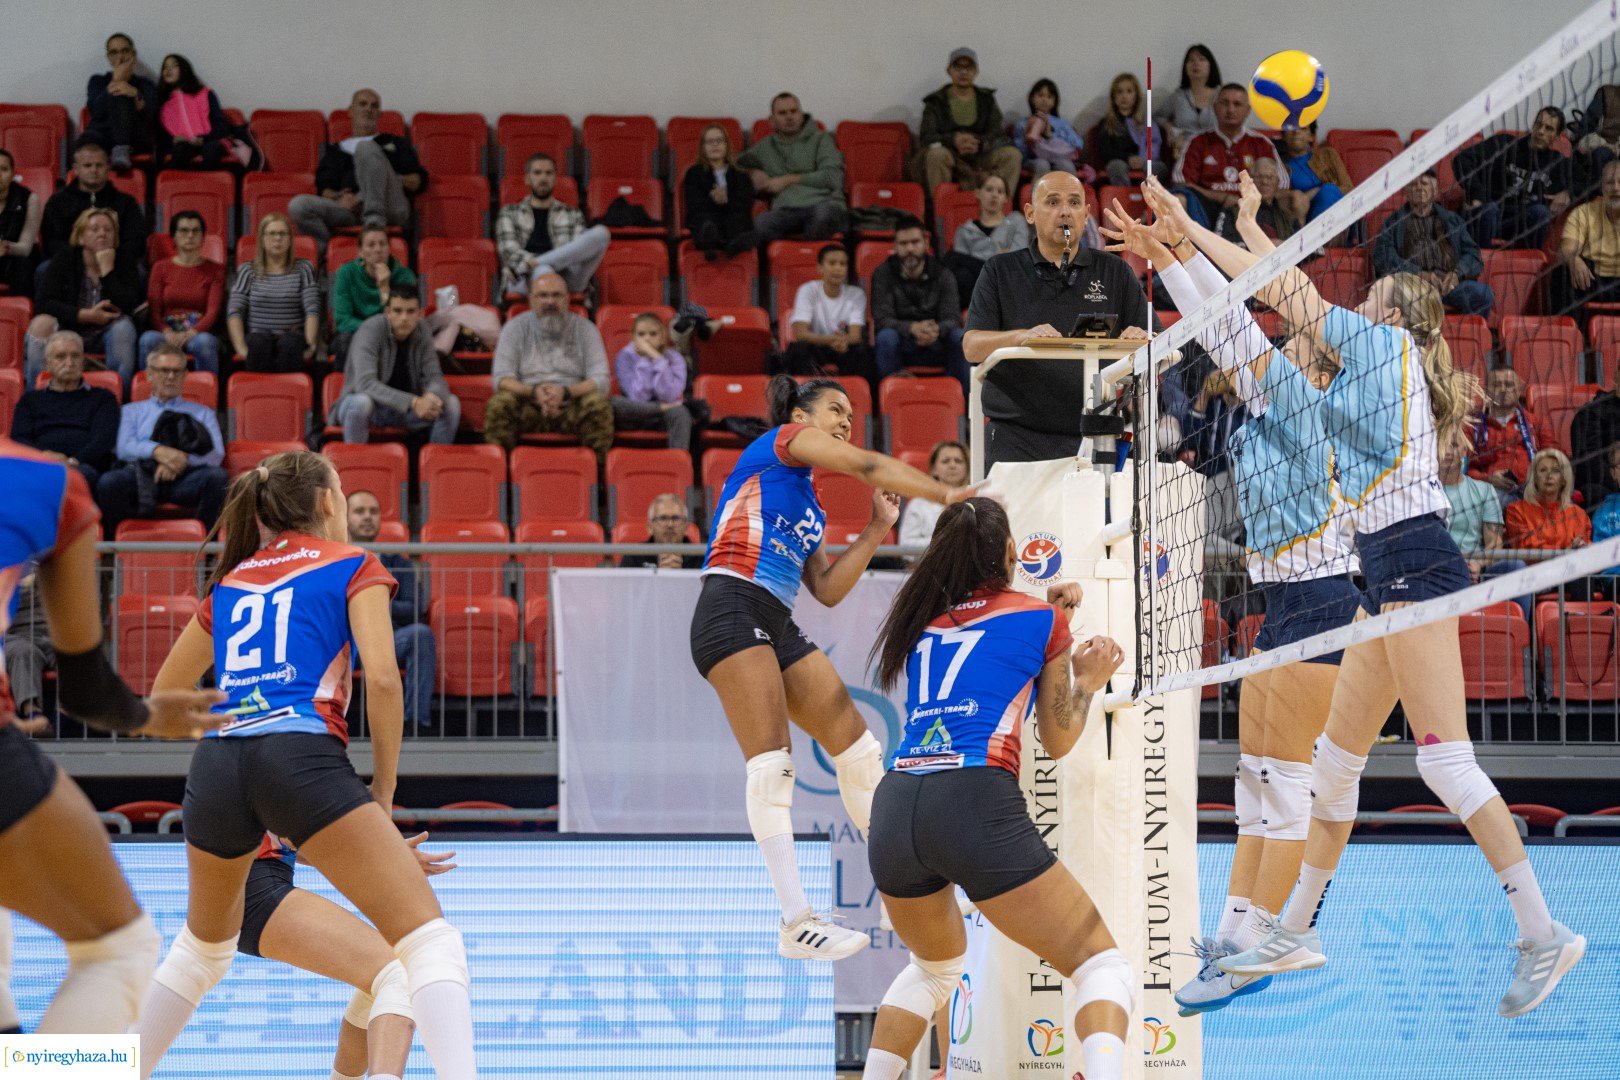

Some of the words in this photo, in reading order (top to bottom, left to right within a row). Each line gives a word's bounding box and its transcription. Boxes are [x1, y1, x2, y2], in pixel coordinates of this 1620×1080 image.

[794, 507, 824, 554] 22
[1029, 533, 1057, 543] FATUM
[225, 587, 294, 672] 21
[916, 629, 986, 705] 17
